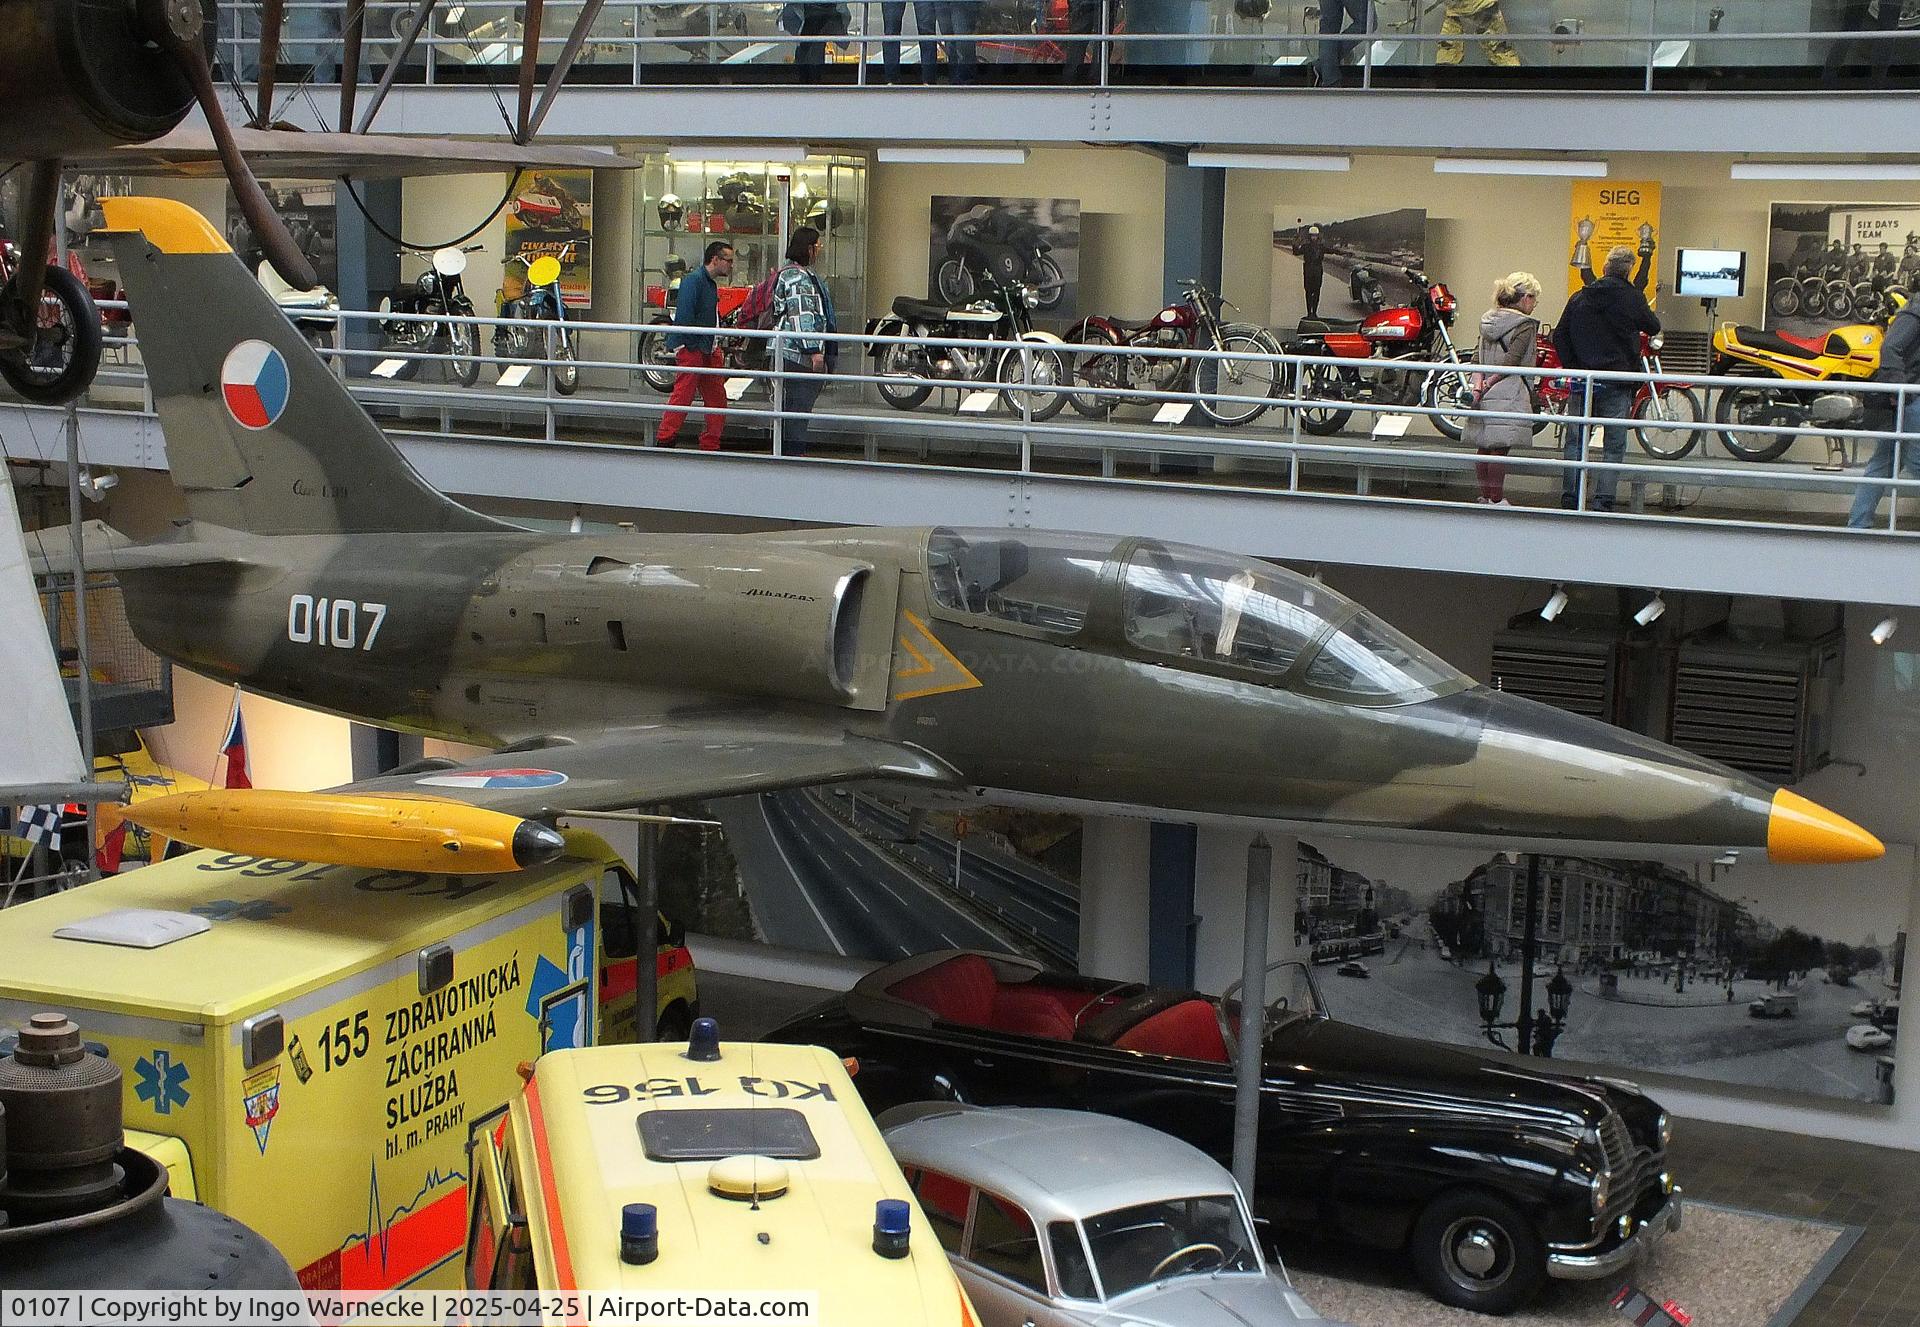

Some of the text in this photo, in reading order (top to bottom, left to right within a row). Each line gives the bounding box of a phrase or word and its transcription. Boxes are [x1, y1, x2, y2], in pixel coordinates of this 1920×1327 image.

[1599, 189, 1640, 206] SIEG
[1857, 220, 1899, 229] SIX DAYS
[1857, 230, 1882, 239] TEAM
[1004, 257, 1013, 272] 9
[288, 593, 387, 651] 0107
[385, 950, 520, 1046] ZDRAVOTNICKÁ
[318, 1009, 370, 1073] 155
[385, 1000, 497, 1089] ZÁCHRANNÁ
[386, 1069, 459, 1130] SLUŽBA
[583, 1076, 838, 1105] KQ 156
[385, 1101, 466, 1161] hl. m. PRAHY
